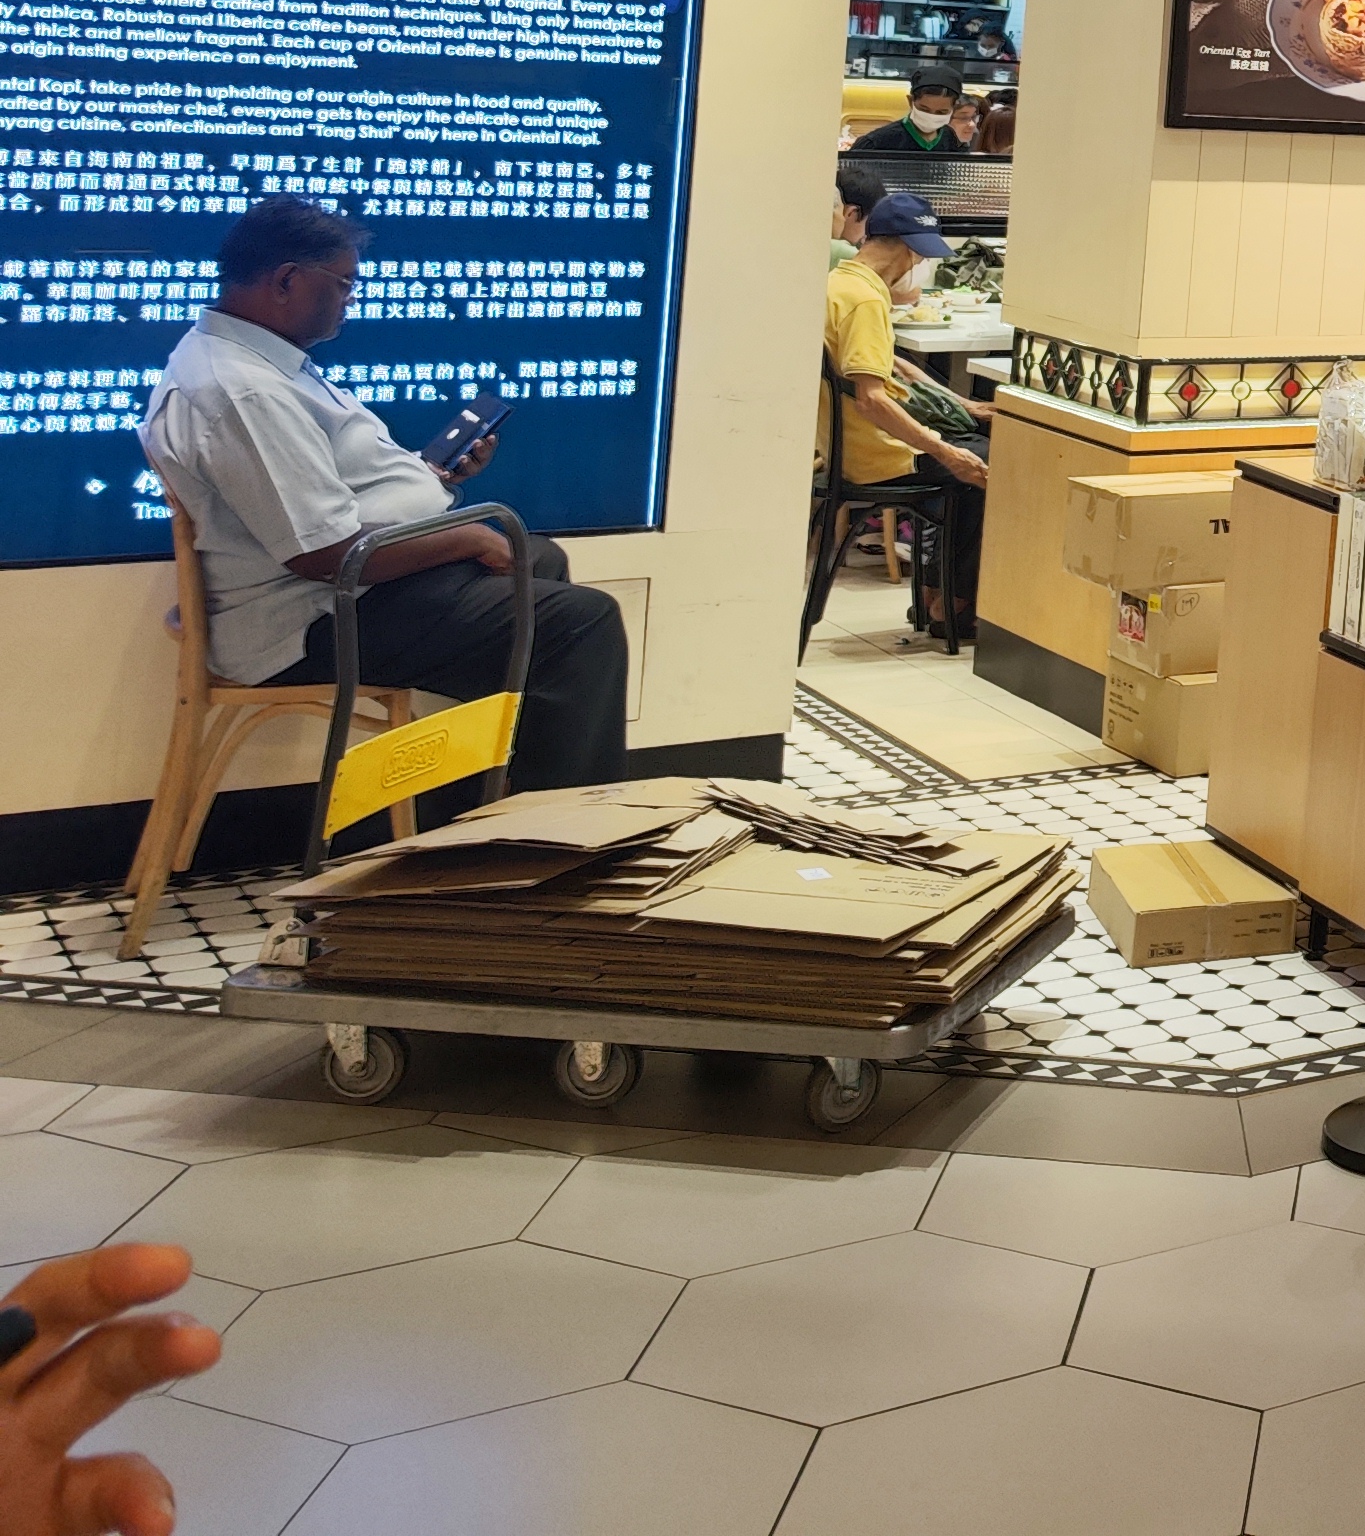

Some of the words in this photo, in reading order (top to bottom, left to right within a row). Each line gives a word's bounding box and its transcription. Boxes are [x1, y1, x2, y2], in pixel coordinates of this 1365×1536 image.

[615, 4, 646, 19] cup
[648, 1, 667, 16] of
[1199, 44, 1235, 56] Oriental
[1236, 47, 1252, 59] Egg
[1253, 48, 1271, 58] Tart
[89, 79, 132, 94] take
[134, 81, 183, 98] pride
[184, 82, 203, 97] in
[205, 84, 293, 104] upholding
[295, 86, 315, 101] of
[315, 91, 346, 102] our
[346, 88, 394, 107] origin
[395, 90, 453, 106] culture
[454, 92, 471, 106] in
[472, 92, 511, 108] food
[511, 95, 545, 109] and
